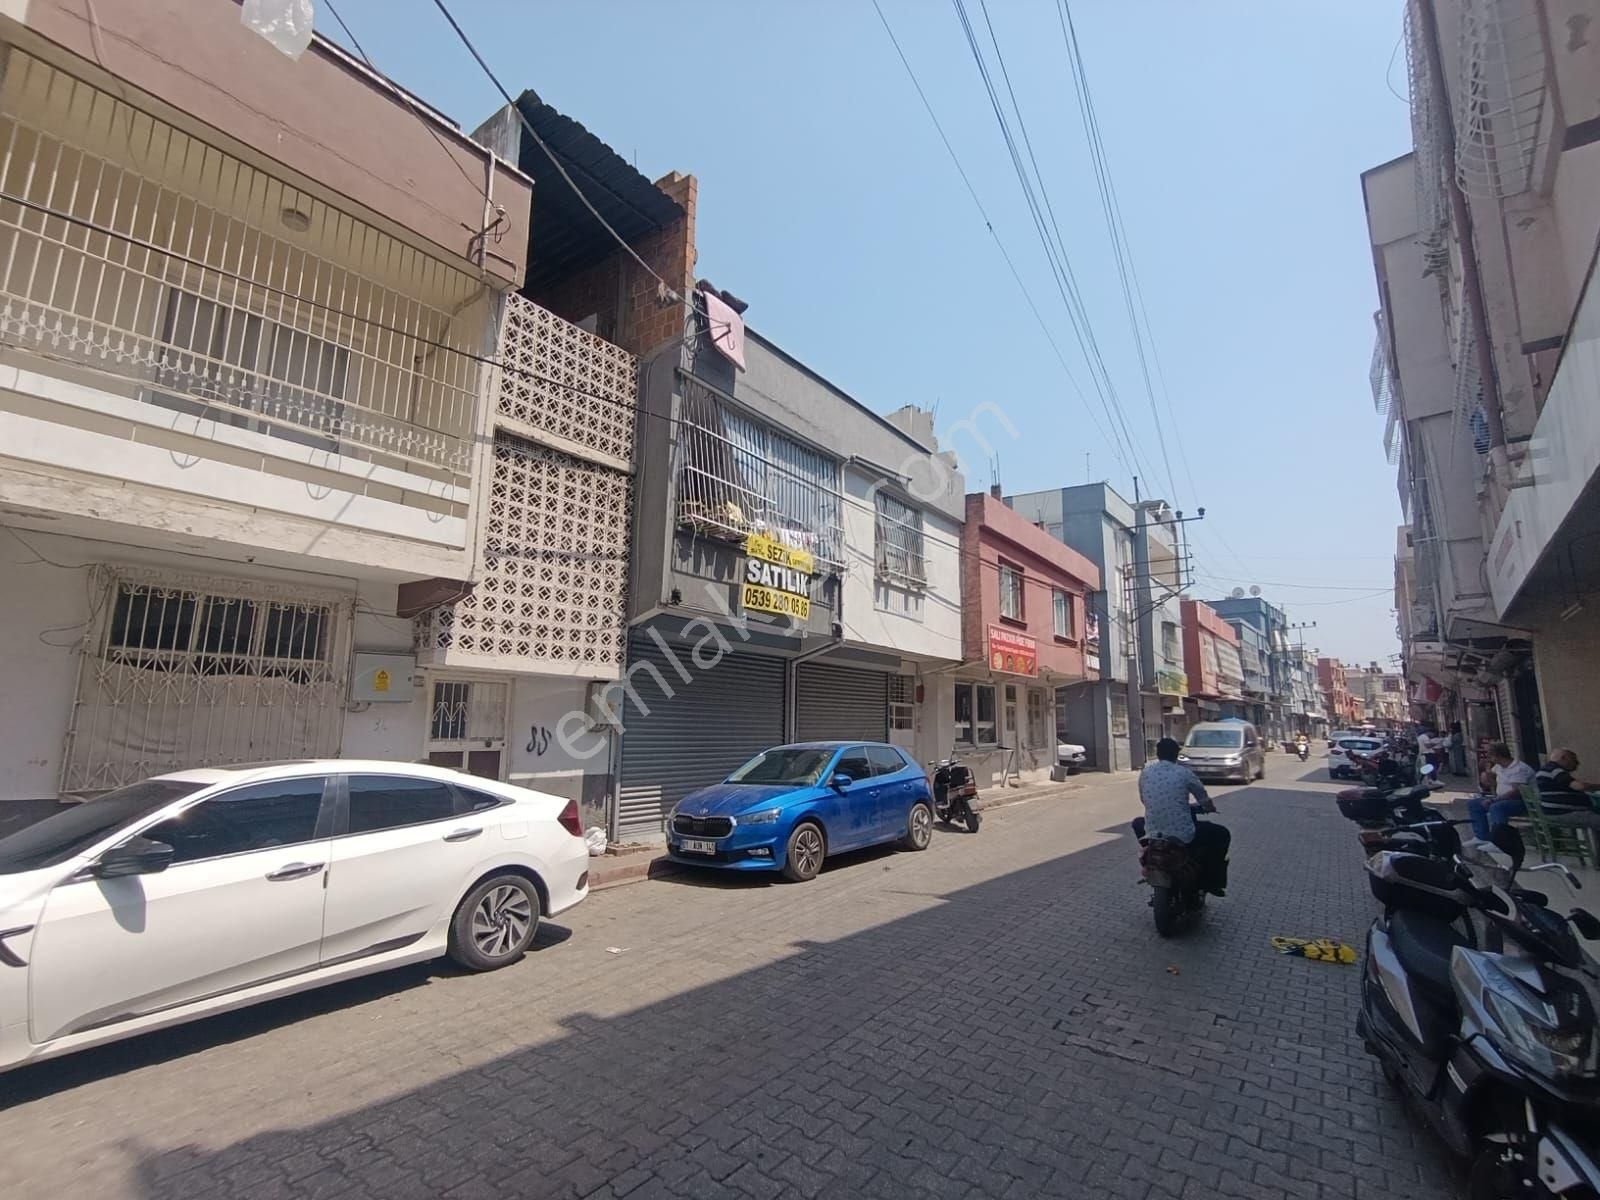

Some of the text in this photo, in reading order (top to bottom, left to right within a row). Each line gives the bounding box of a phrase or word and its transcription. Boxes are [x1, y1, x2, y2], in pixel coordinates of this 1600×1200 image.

[747, 559, 808, 597] SATILIK
[745, 588, 771, 608] 0539
[791, 597, 799, 615] 05
